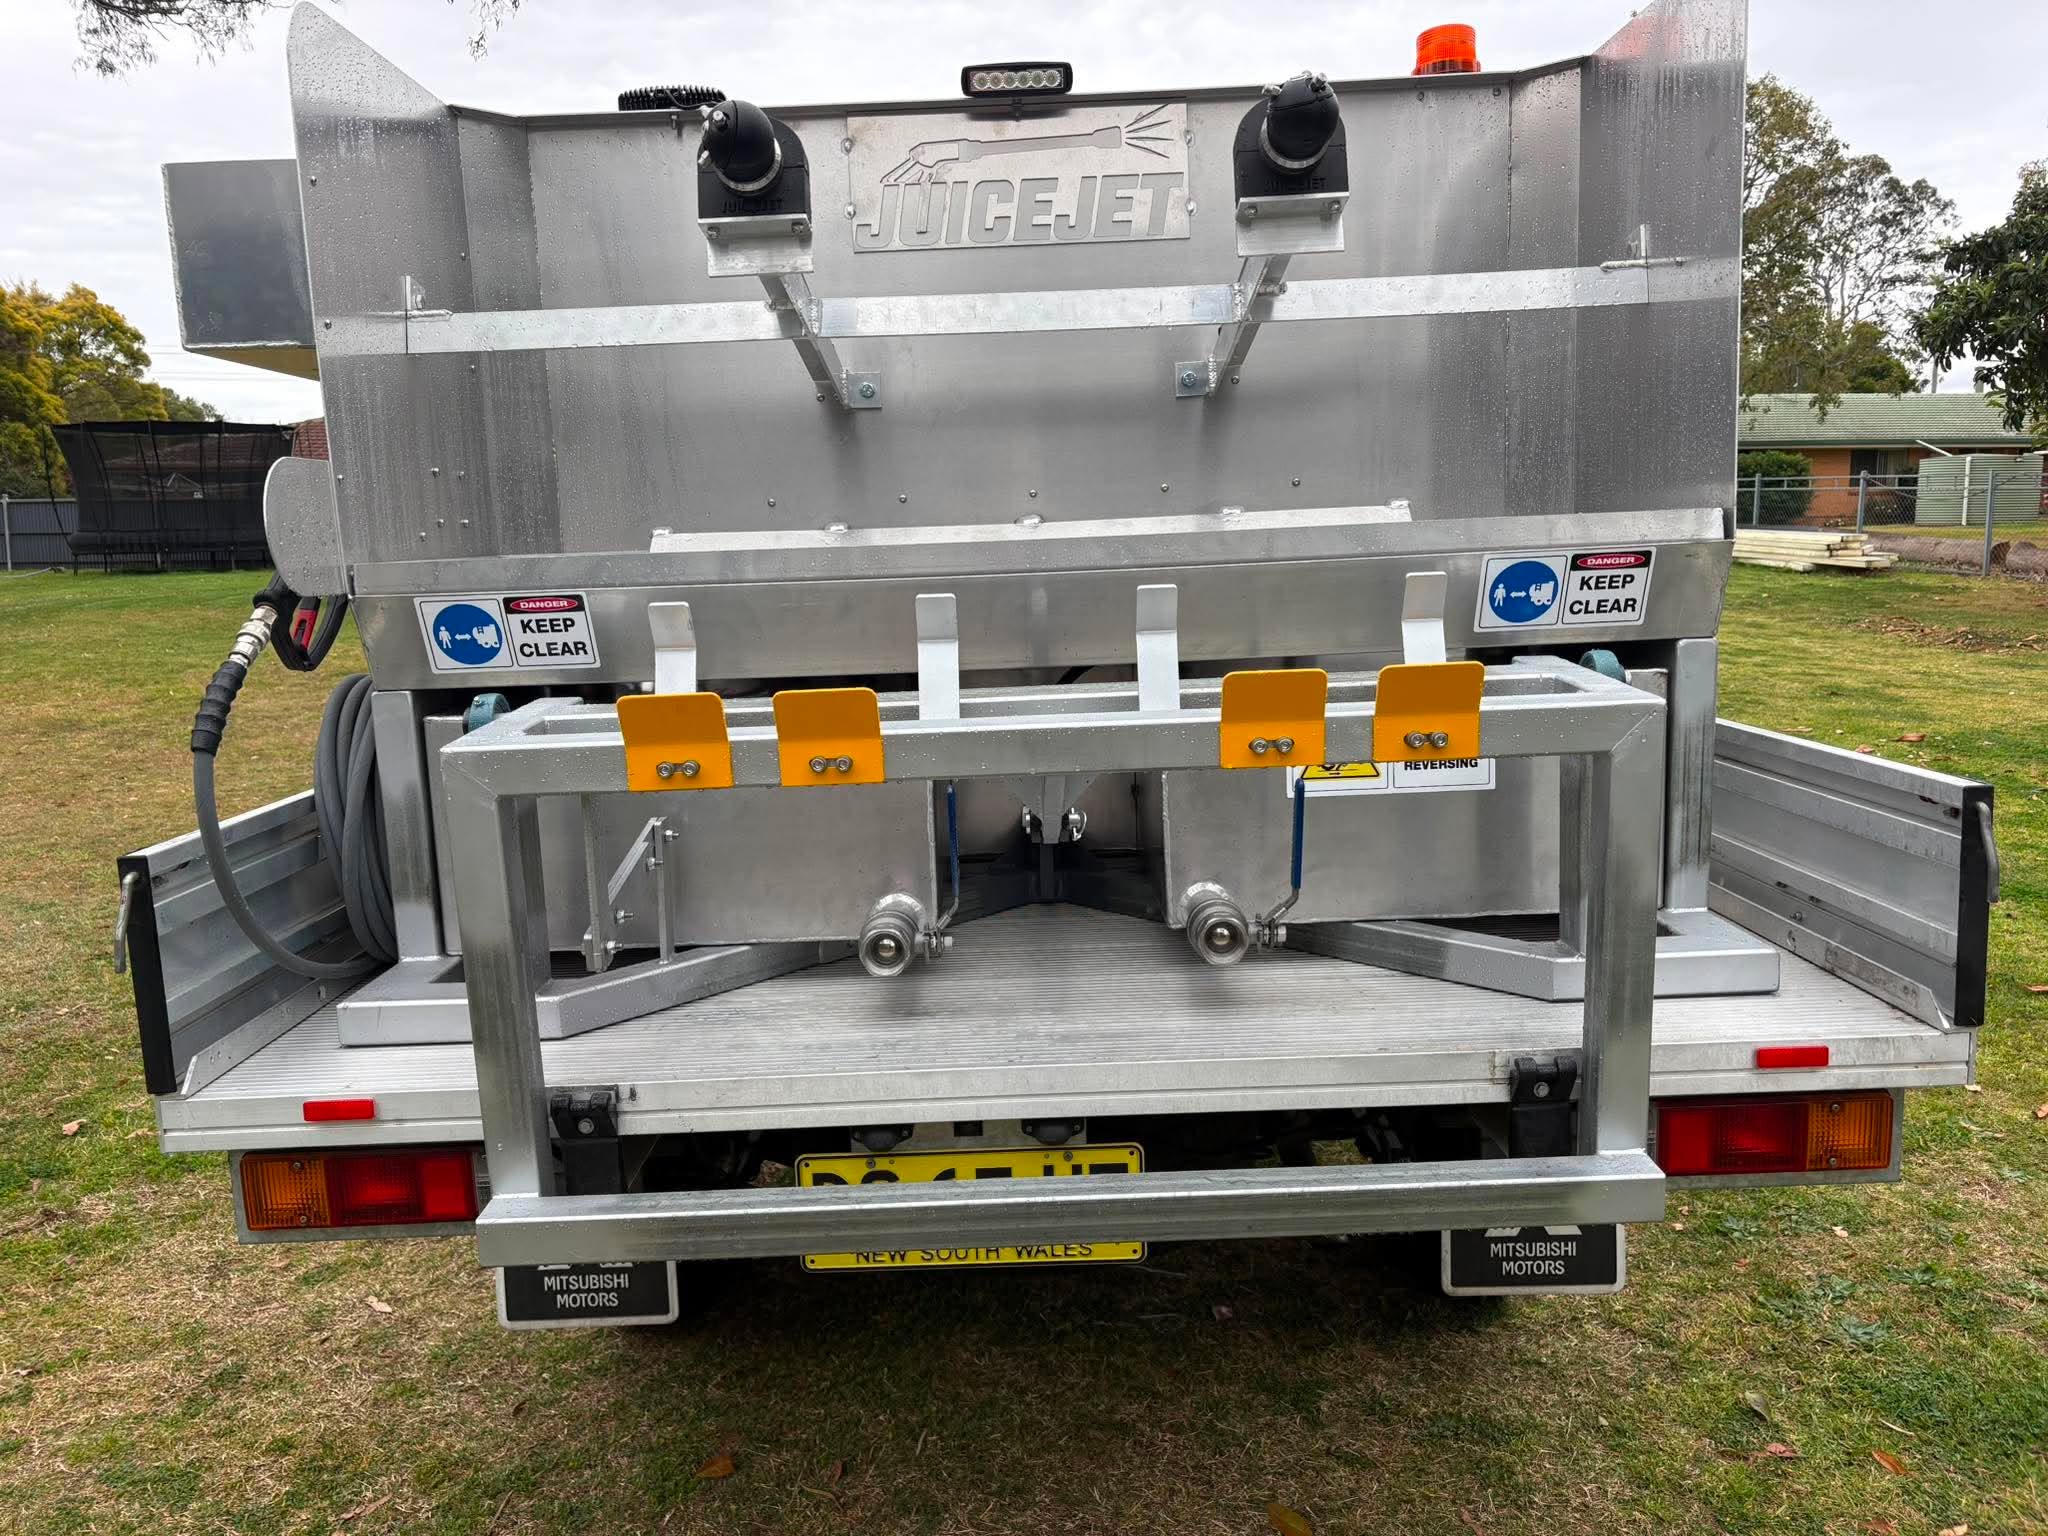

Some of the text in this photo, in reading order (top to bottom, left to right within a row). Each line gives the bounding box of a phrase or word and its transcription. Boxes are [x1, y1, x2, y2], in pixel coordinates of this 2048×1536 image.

[855, 172, 1184, 248] JUICEJET
[1587, 556, 1635, 565] DANGER
[1579, 574, 1635, 591] KEEP
[520, 600, 568, 609] DANGER
[1569, 597, 1637, 615] CLEAR
[520, 618, 576, 634] KEEP
[519, 641, 588, 658] CLEAR
[1404, 758, 1478, 771] REVERSING
[856, 1242, 1092, 1264] NEW SOUTH WALES
[1490, 1241, 1577, 1257] MITSUBISHI
[1502, 1260, 1565, 1276] MOTORS
[544, 1273, 629, 1292] MITSUBISHI
[556, 1292, 619, 1309] MOTORS
